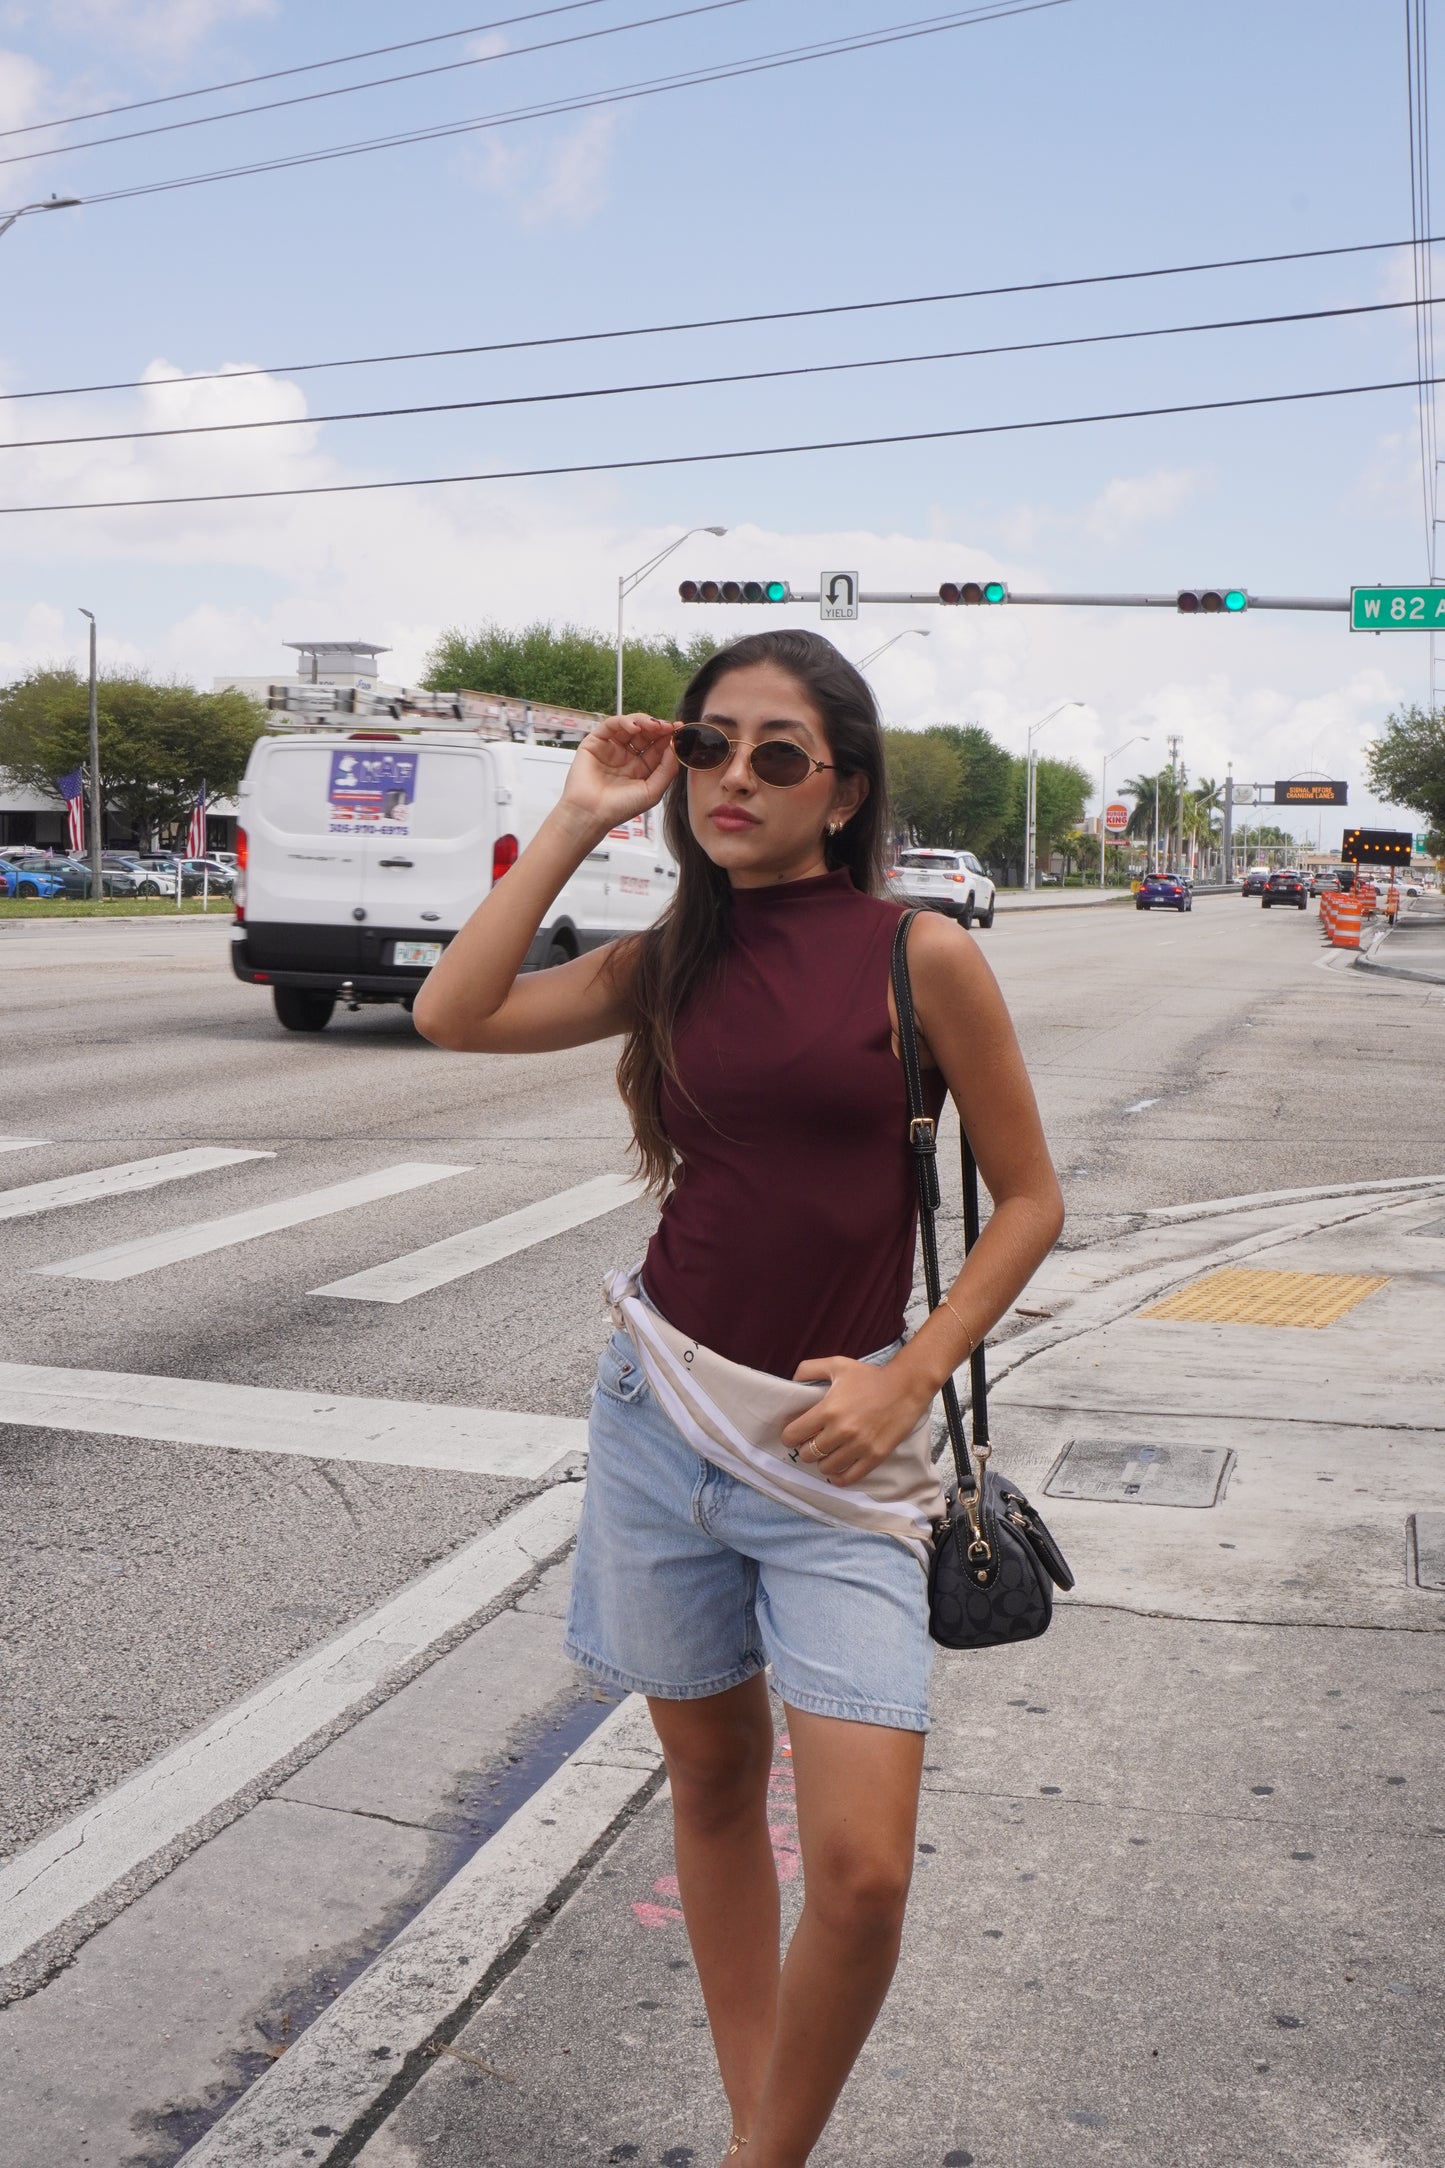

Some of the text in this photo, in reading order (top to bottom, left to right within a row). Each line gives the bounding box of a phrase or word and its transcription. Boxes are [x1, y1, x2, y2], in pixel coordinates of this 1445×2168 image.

[1364, 599, 1381, 618] W
[1390, 597, 1425, 620] 82
[825, 609, 853, 617] YIELD
[1106, 816, 1128, 824] KING
